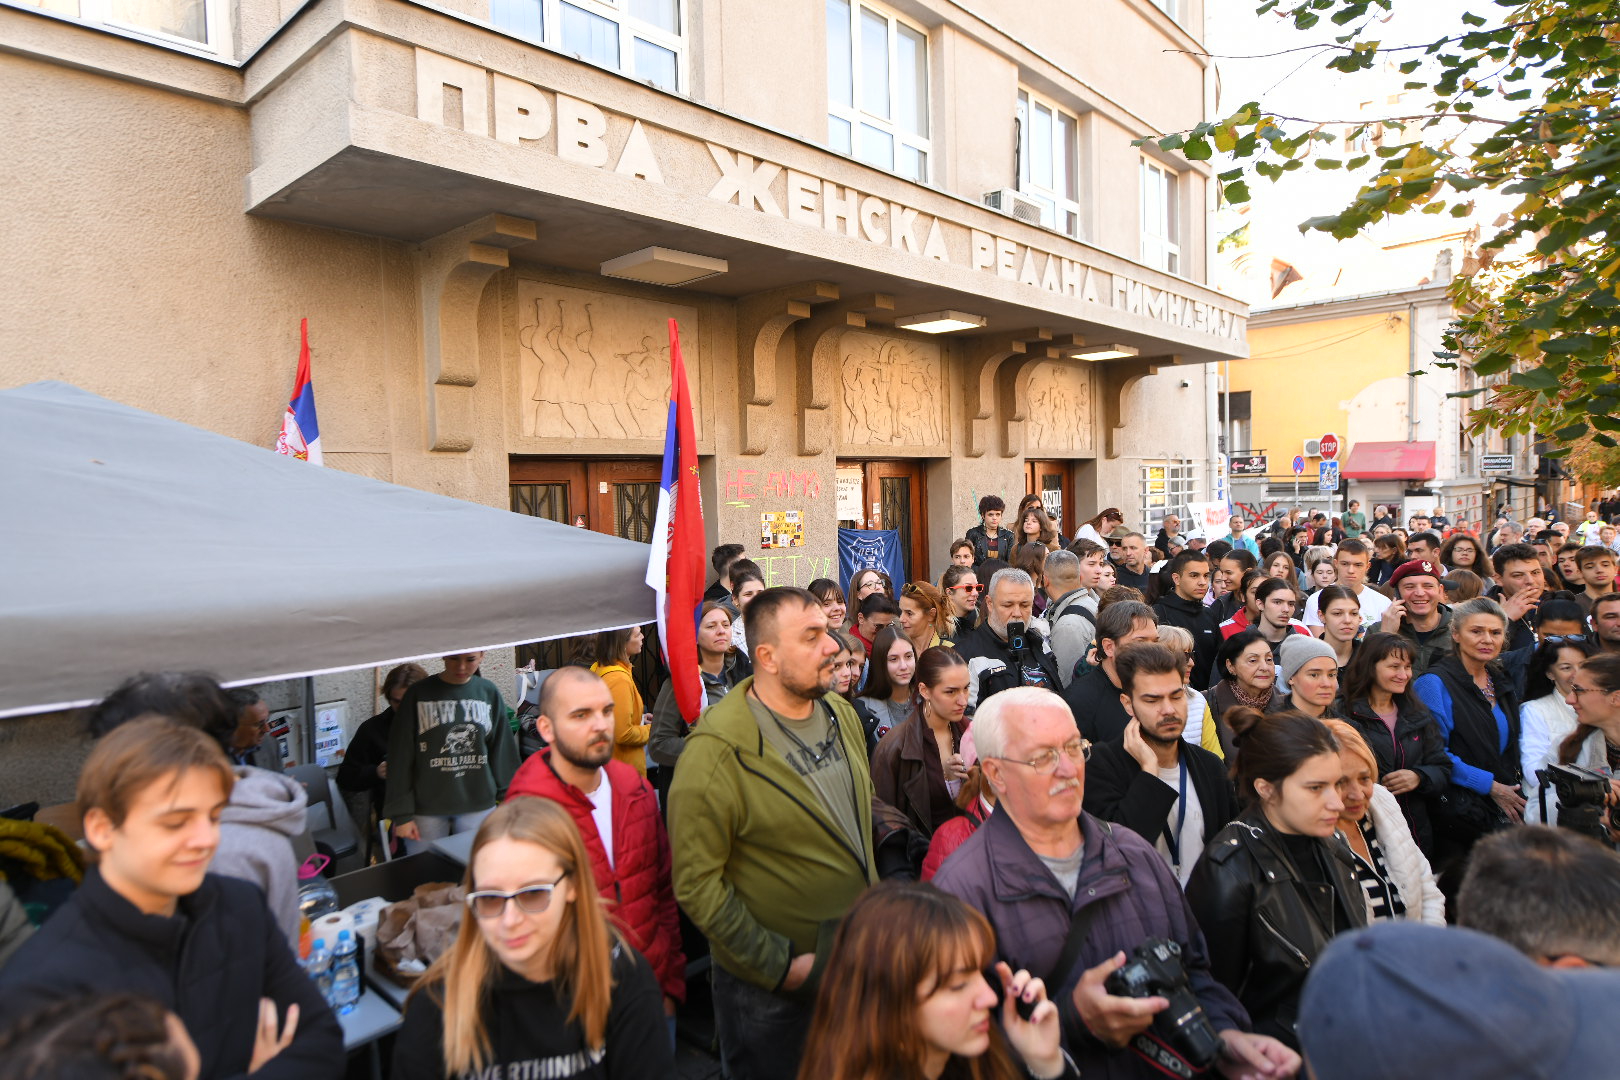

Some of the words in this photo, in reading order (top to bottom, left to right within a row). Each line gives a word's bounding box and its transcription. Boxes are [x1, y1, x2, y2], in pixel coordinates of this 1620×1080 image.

[415, 47, 666, 184] ПРВА
[705, 142, 951, 262] ЖЕНСКА
[971, 229, 1100, 304] РЕАЛНА
[1112, 273, 1241, 341] ГИМНАЗИЈА
[1321, 442, 1336, 453] STOP
[726, 467, 758, 501] НЕ
[1043, 491, 1061, 506] ANTI
[417, 701, 458, 735] NEW
